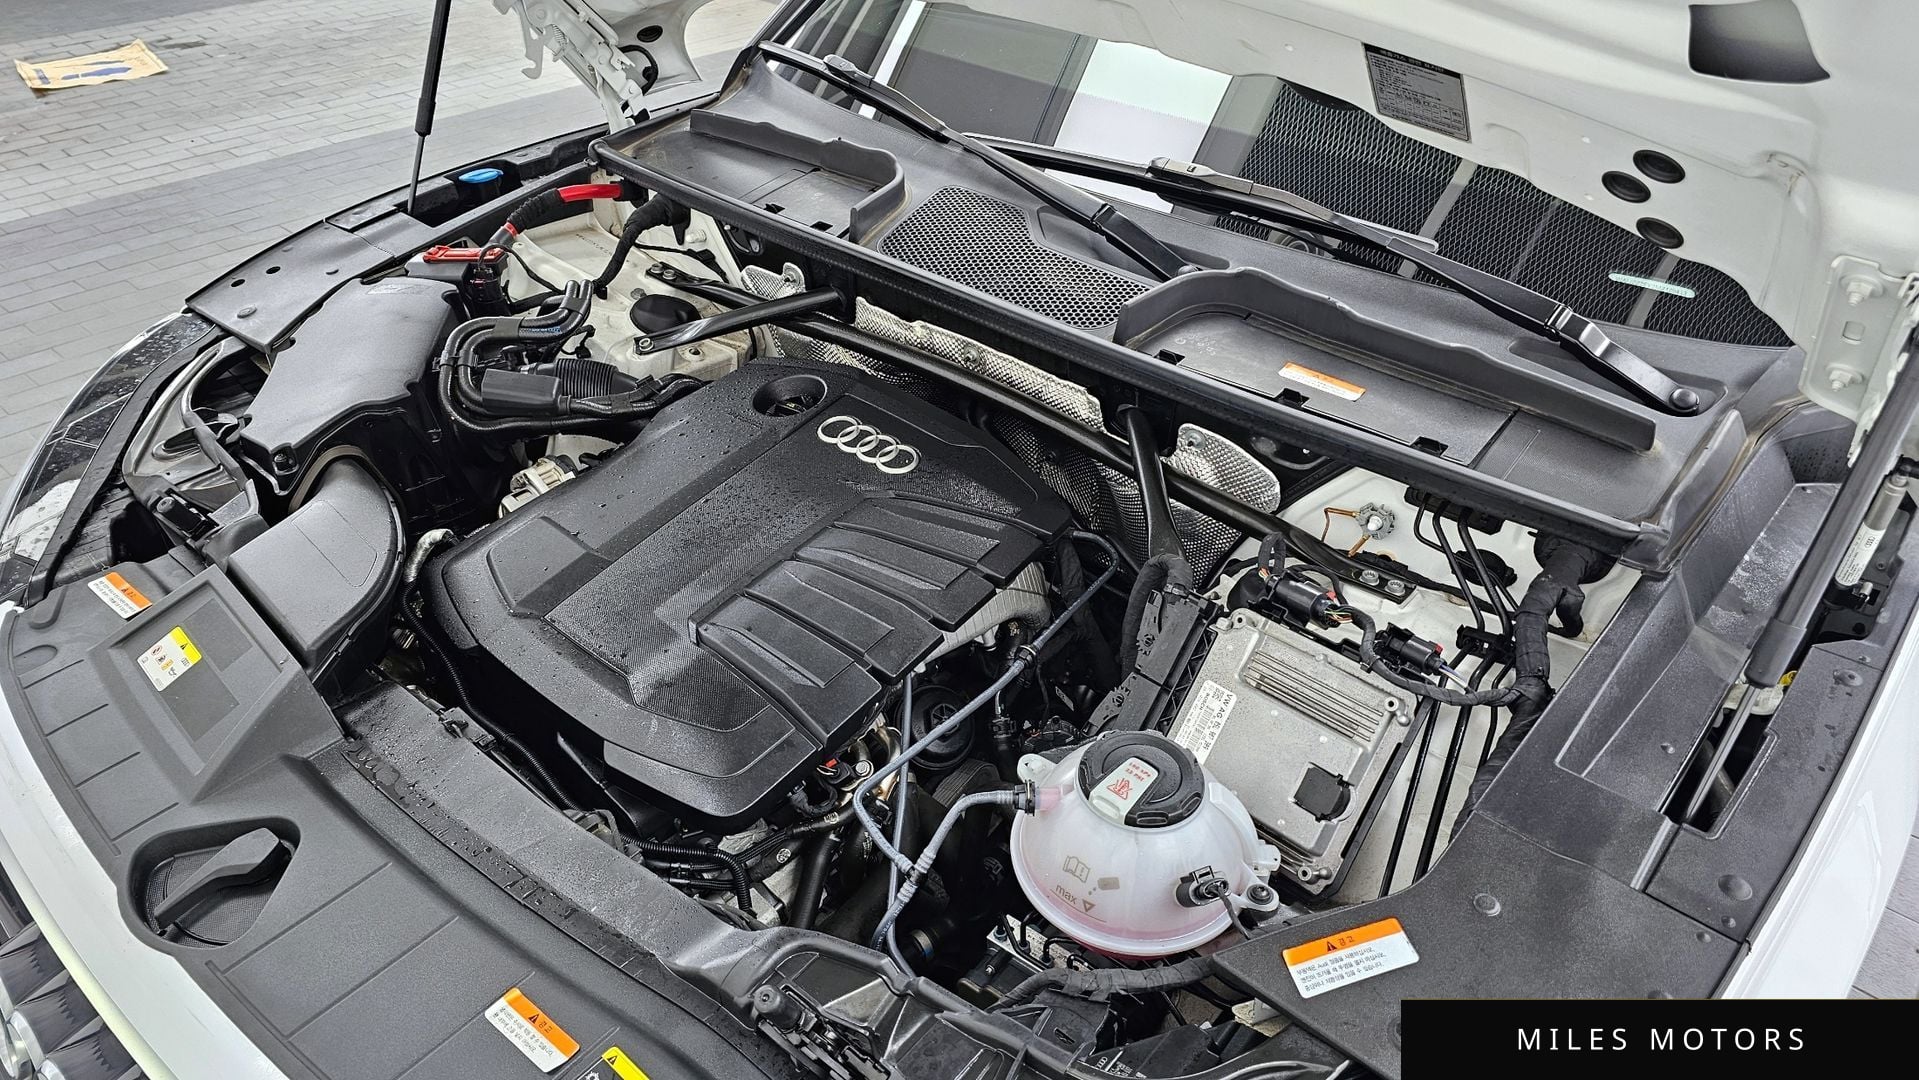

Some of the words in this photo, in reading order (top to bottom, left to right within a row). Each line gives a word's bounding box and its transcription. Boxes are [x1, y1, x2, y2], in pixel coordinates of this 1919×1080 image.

[1222, 694, 1234, 707] VW
[1216, 707, 1226, 718] AG
[1055, 885, 1077, 904] max
